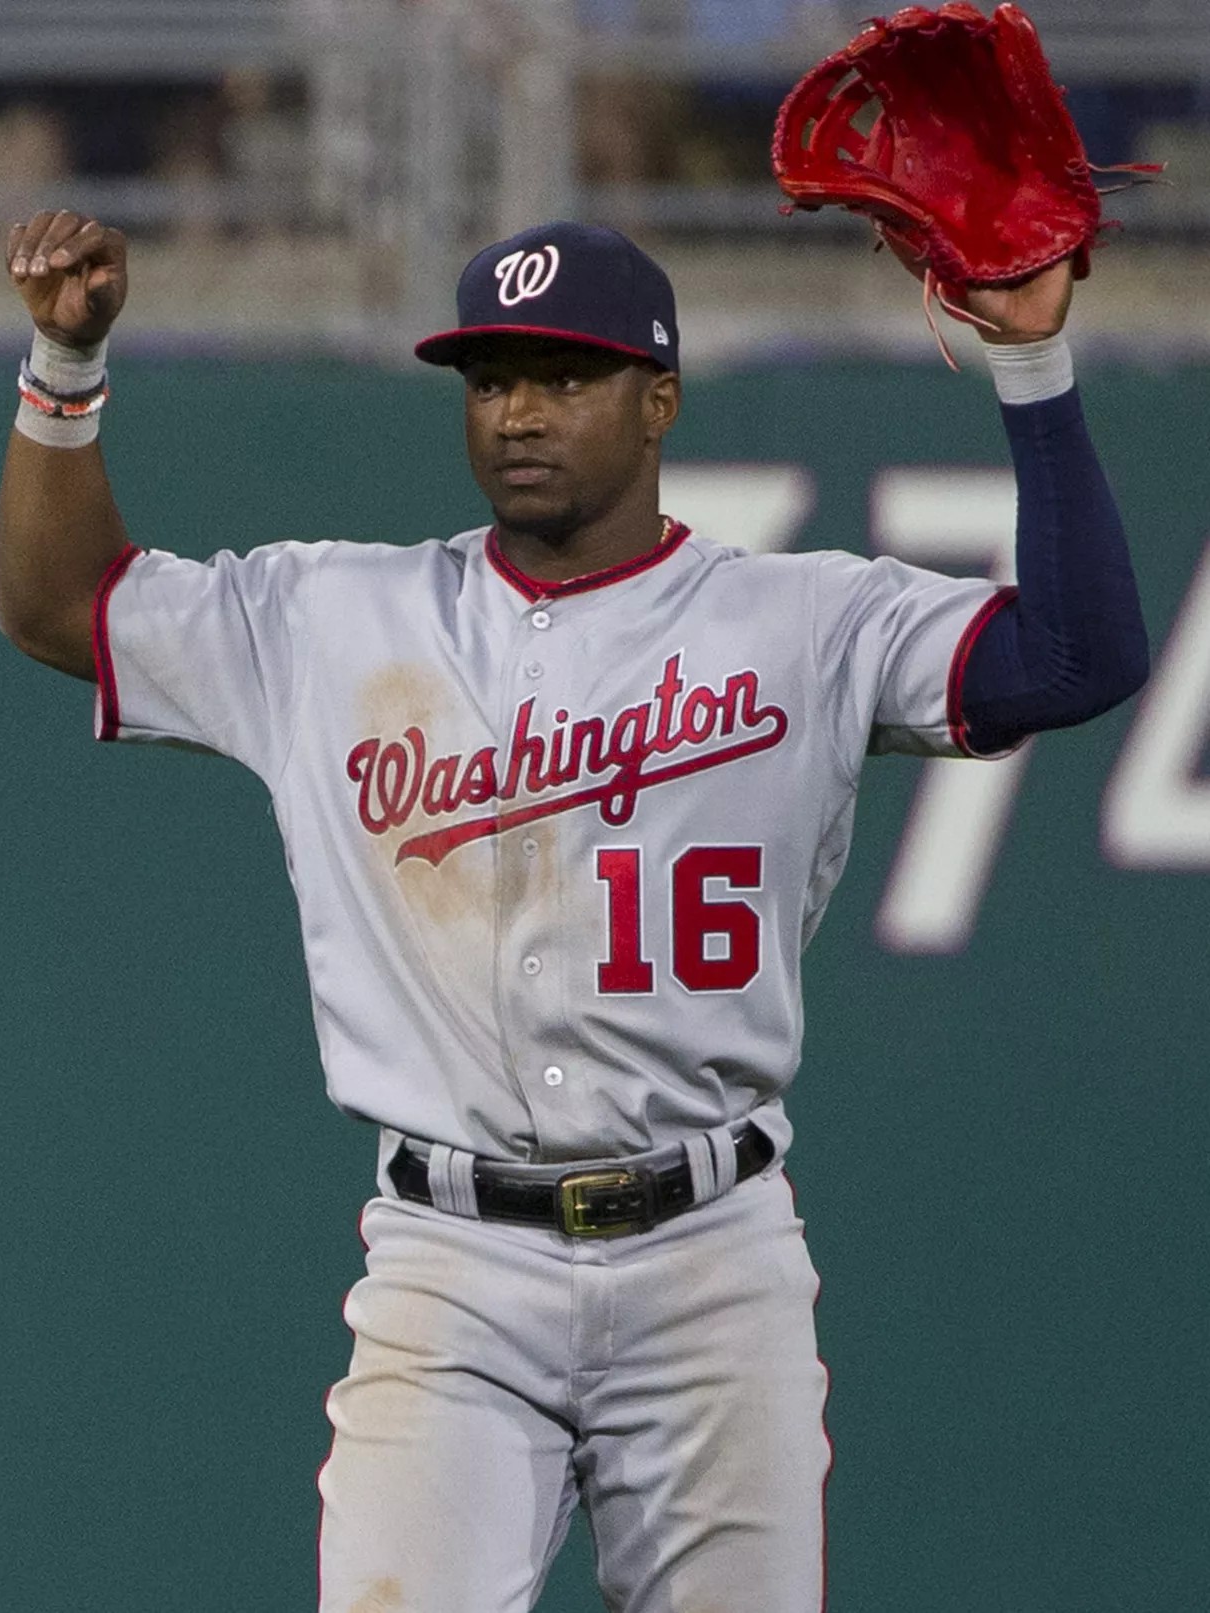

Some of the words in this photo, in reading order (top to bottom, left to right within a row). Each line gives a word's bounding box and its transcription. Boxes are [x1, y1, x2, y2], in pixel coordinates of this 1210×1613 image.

[495, 244, 560, 307] W
[346, 647, 789, 870] Washington
[593, 843, 765, 997] 16
